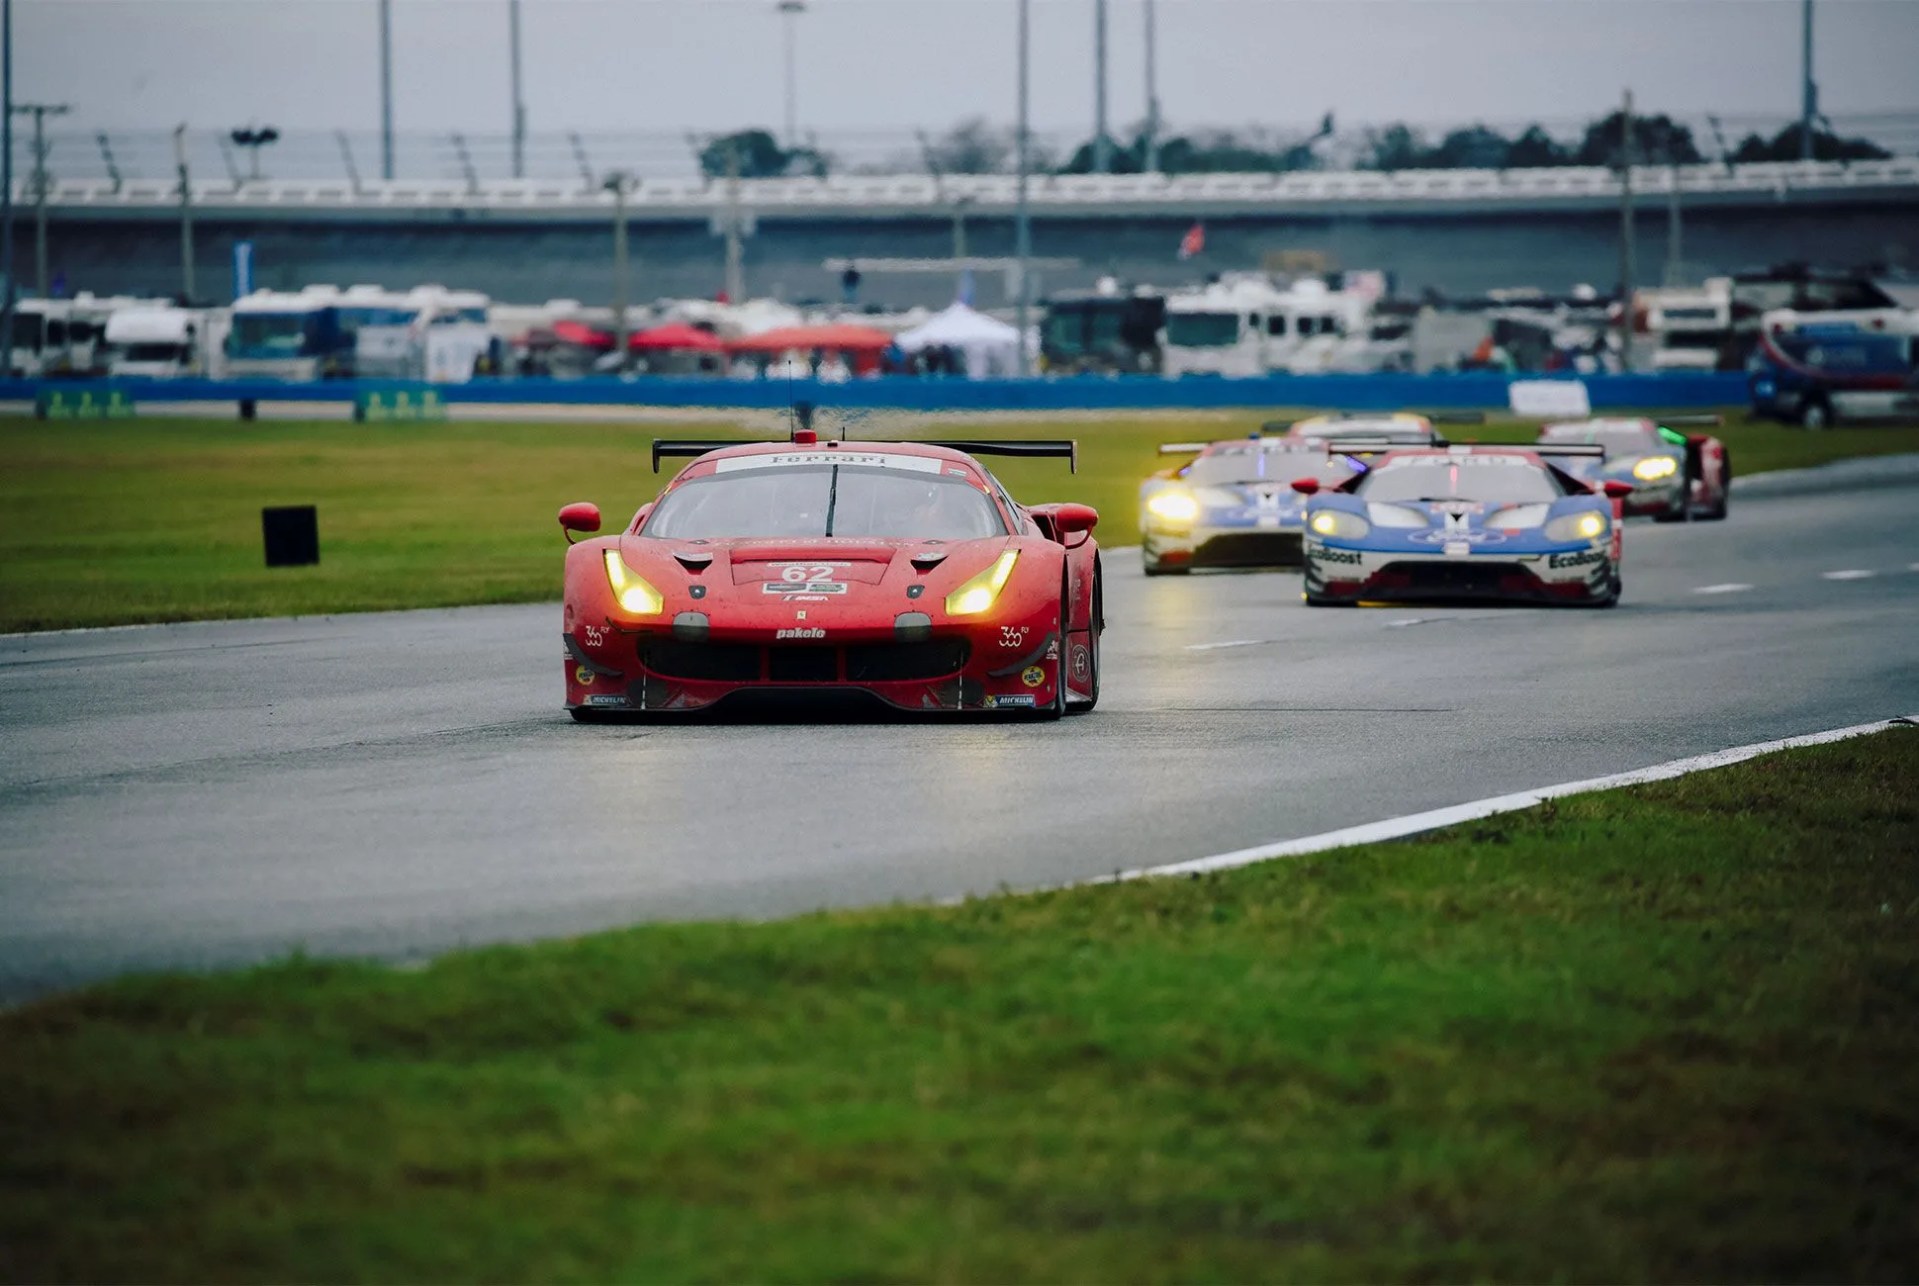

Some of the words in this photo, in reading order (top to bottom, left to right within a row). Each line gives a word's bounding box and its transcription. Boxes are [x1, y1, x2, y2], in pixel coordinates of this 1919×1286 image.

[773, 456, 885, 464] Ferrari
[782, 566, 834, 583] 62
[776, 627, 826, 639] pakelo
